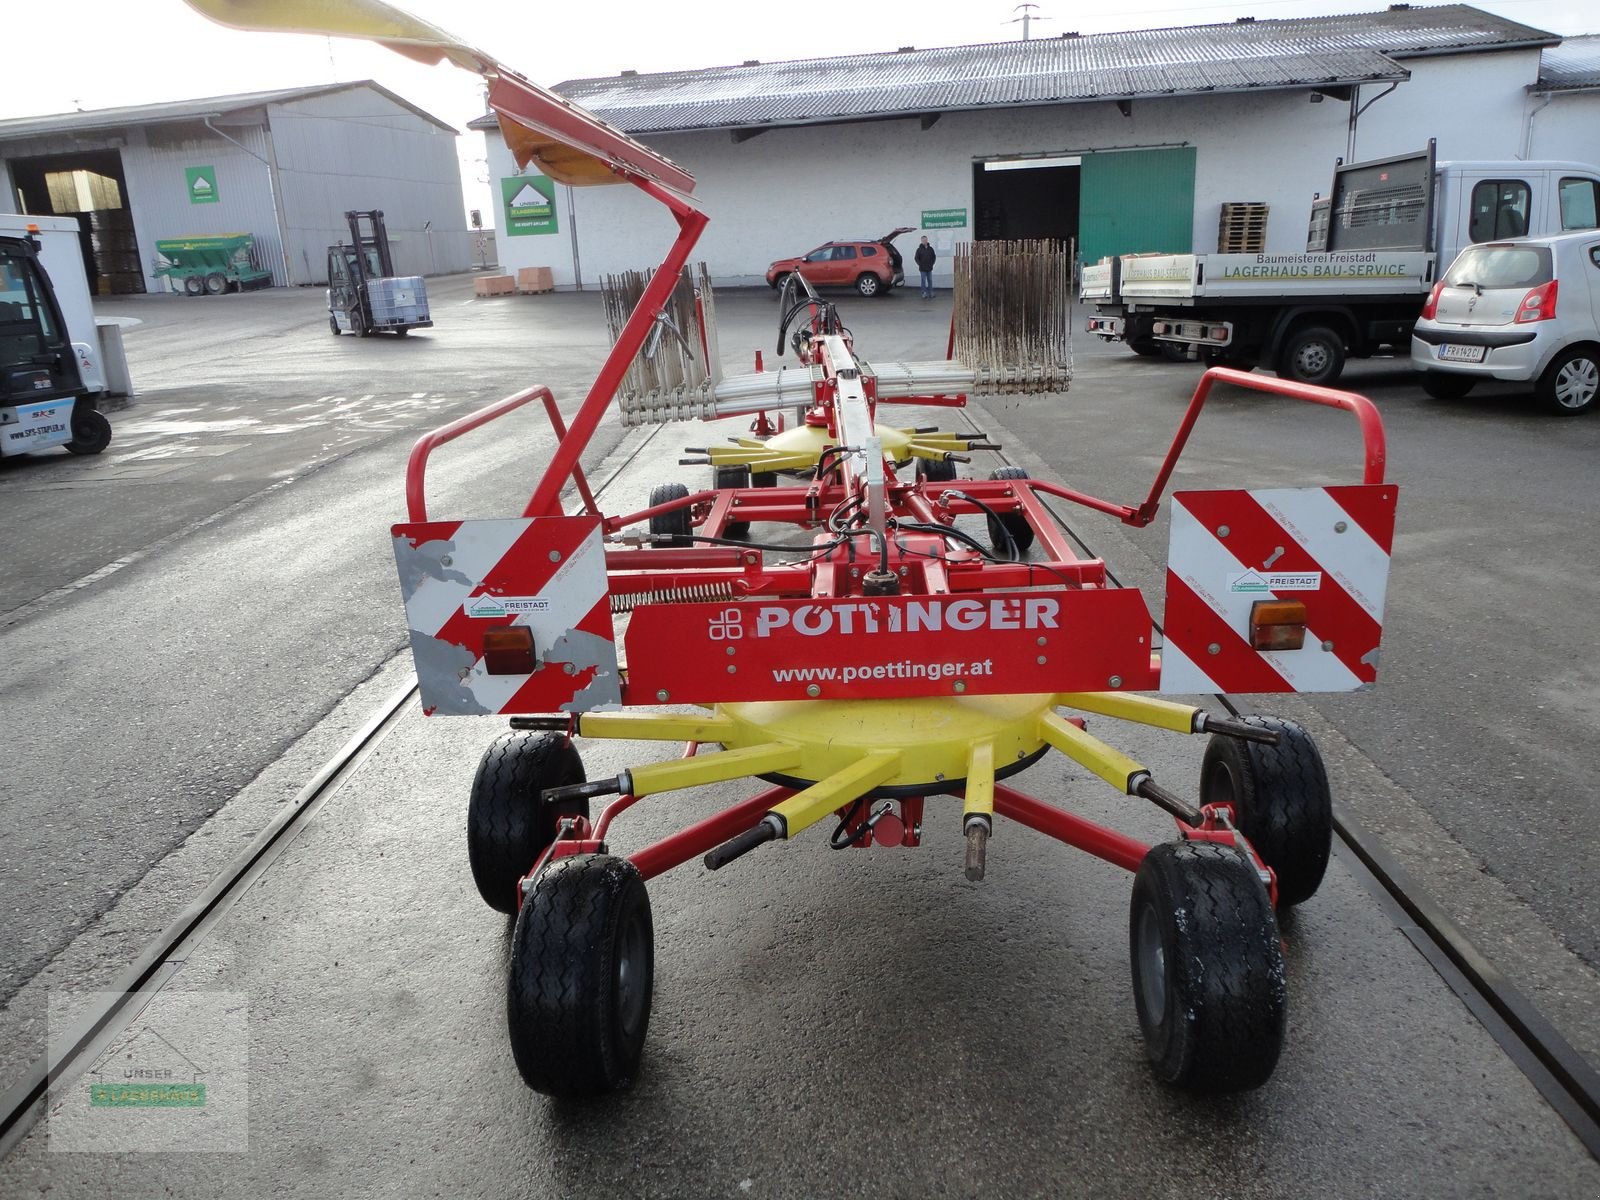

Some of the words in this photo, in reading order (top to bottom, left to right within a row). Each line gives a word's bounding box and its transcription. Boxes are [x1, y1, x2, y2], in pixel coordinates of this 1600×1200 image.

[1257, 254, 1328, 264] Baumeisterei
[1329, 253, 1376, 263] Freistadt
[1224, 265, 1308, 278] LAGERHAUS
[1313, 264, 1406, 276] BAU-SERVICE
[32, 409, 55, 418] SKS
[772, 658, 993, 683] www.poettinger.at
